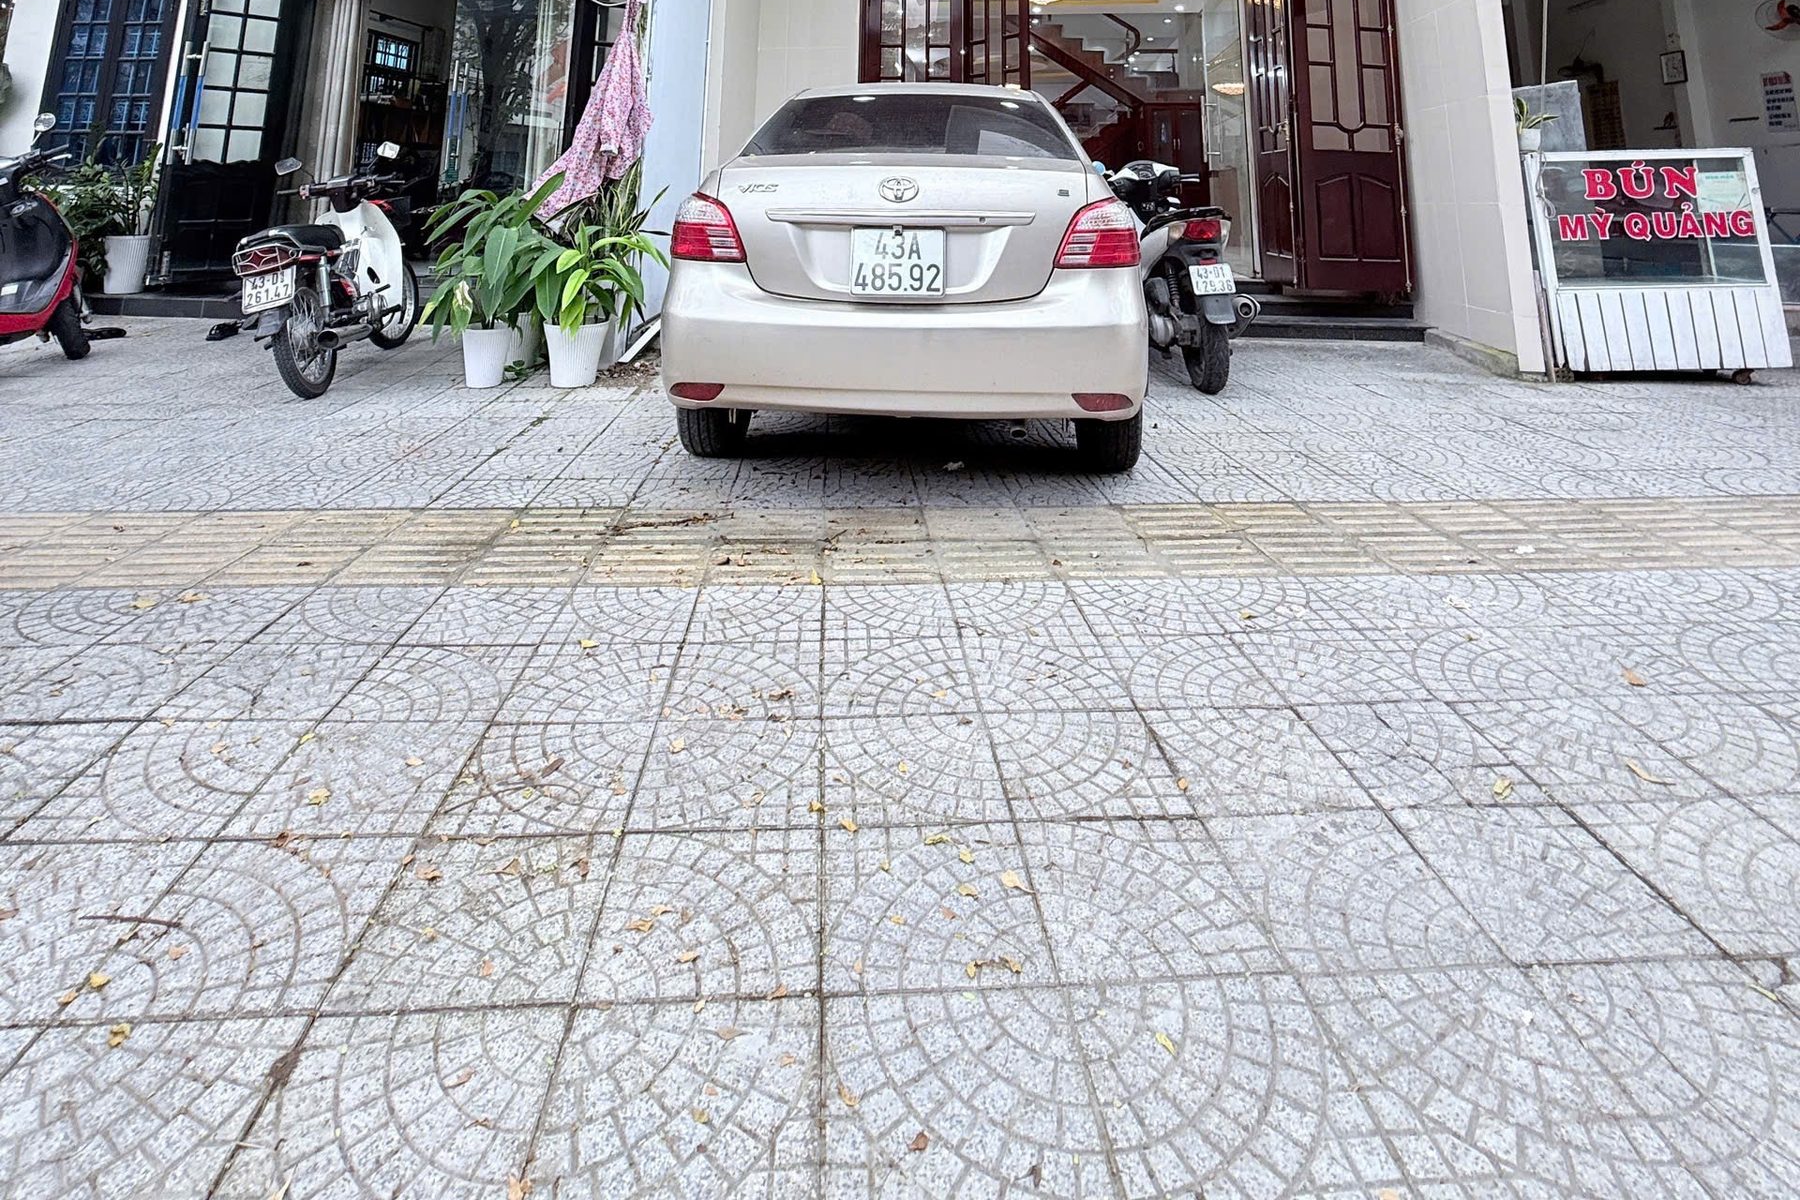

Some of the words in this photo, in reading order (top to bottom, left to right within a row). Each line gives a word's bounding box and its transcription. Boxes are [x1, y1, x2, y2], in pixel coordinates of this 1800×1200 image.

[1581, 160, 1699, 200] BÚN
[1557, 206, 1614, 241] MỲ
[1623, 202, 1756, 241] QUẢNG
[875, 232, 921, 260] 43A
[854, 263, 940, 292] 485.92
[247, 284, 289, 306] 261.47
